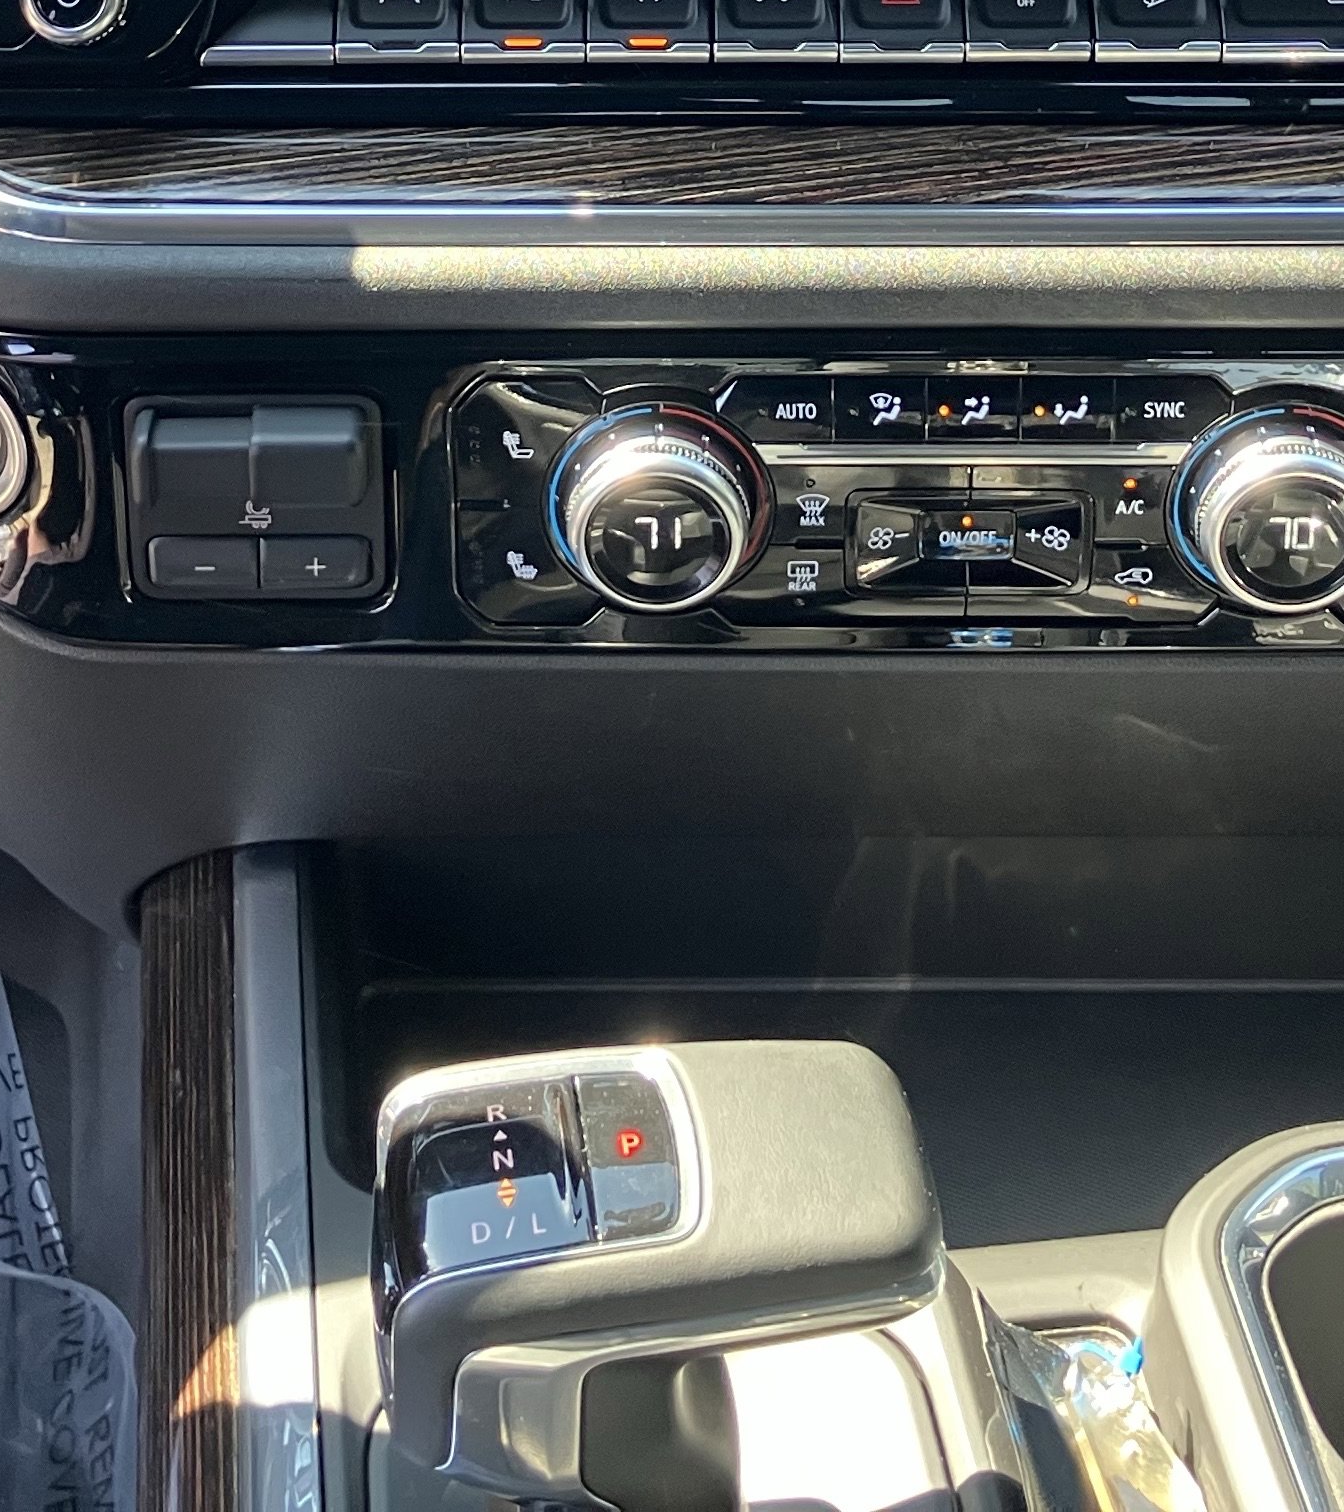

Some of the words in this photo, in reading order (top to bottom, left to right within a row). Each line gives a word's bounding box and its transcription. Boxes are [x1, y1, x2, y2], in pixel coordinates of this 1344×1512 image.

[775, 403, 818, 420] AUTO
[1143, 401, 1185, 419] SYNC
[1114, 499, 1145, 515] A/C
[799, 516, 826, 526] MAX
[634, 516, 682, 550] 71
[939, 530, 997, 545] ON/OFF
[1268, 516, 1316, 550] 70
[787, 581, 817, 592] REAR
[486, 1104, 508, 1123] R
[620, 1133, 641, 1156] P
[492, 1148, 515, 1172] N
[471, 1220, 492, 1245] D
[532, 1212, 547, 1237] L
